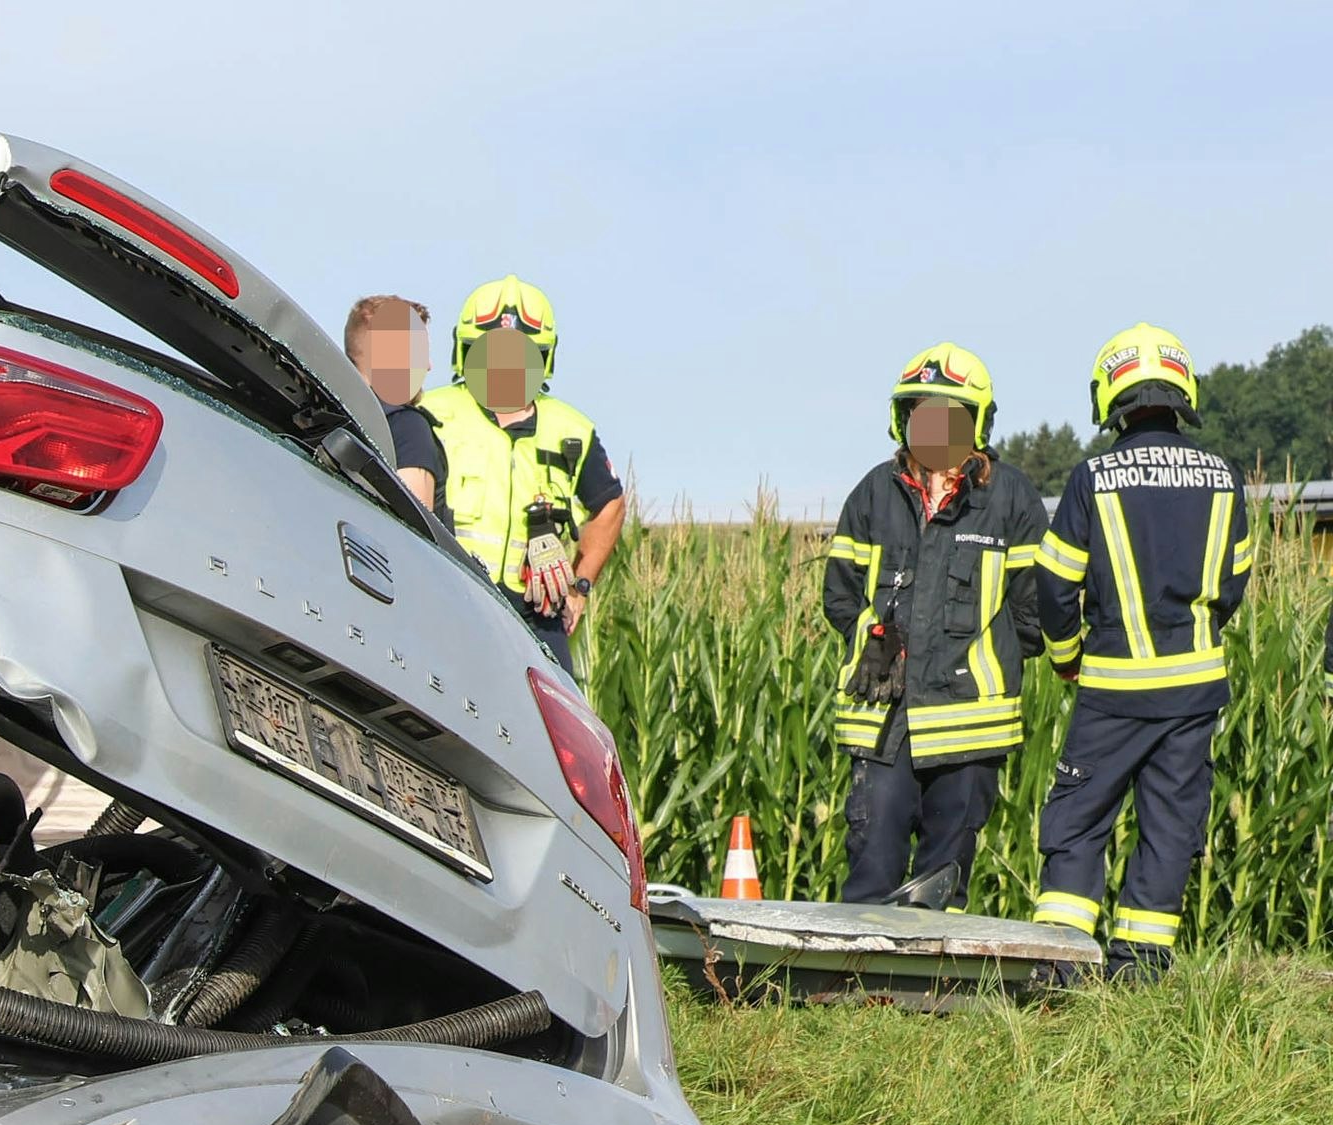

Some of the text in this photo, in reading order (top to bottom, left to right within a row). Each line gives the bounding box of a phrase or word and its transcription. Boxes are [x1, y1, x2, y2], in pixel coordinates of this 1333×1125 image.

[1101, 346, 1138, 372] FEUER
[1087, 446, 1229, 472] FEUERWEHR
[1094, 464, 1234, 492] AUROLZMÜNSTER
[207, 555, 512, 745] ALHAMBRA
